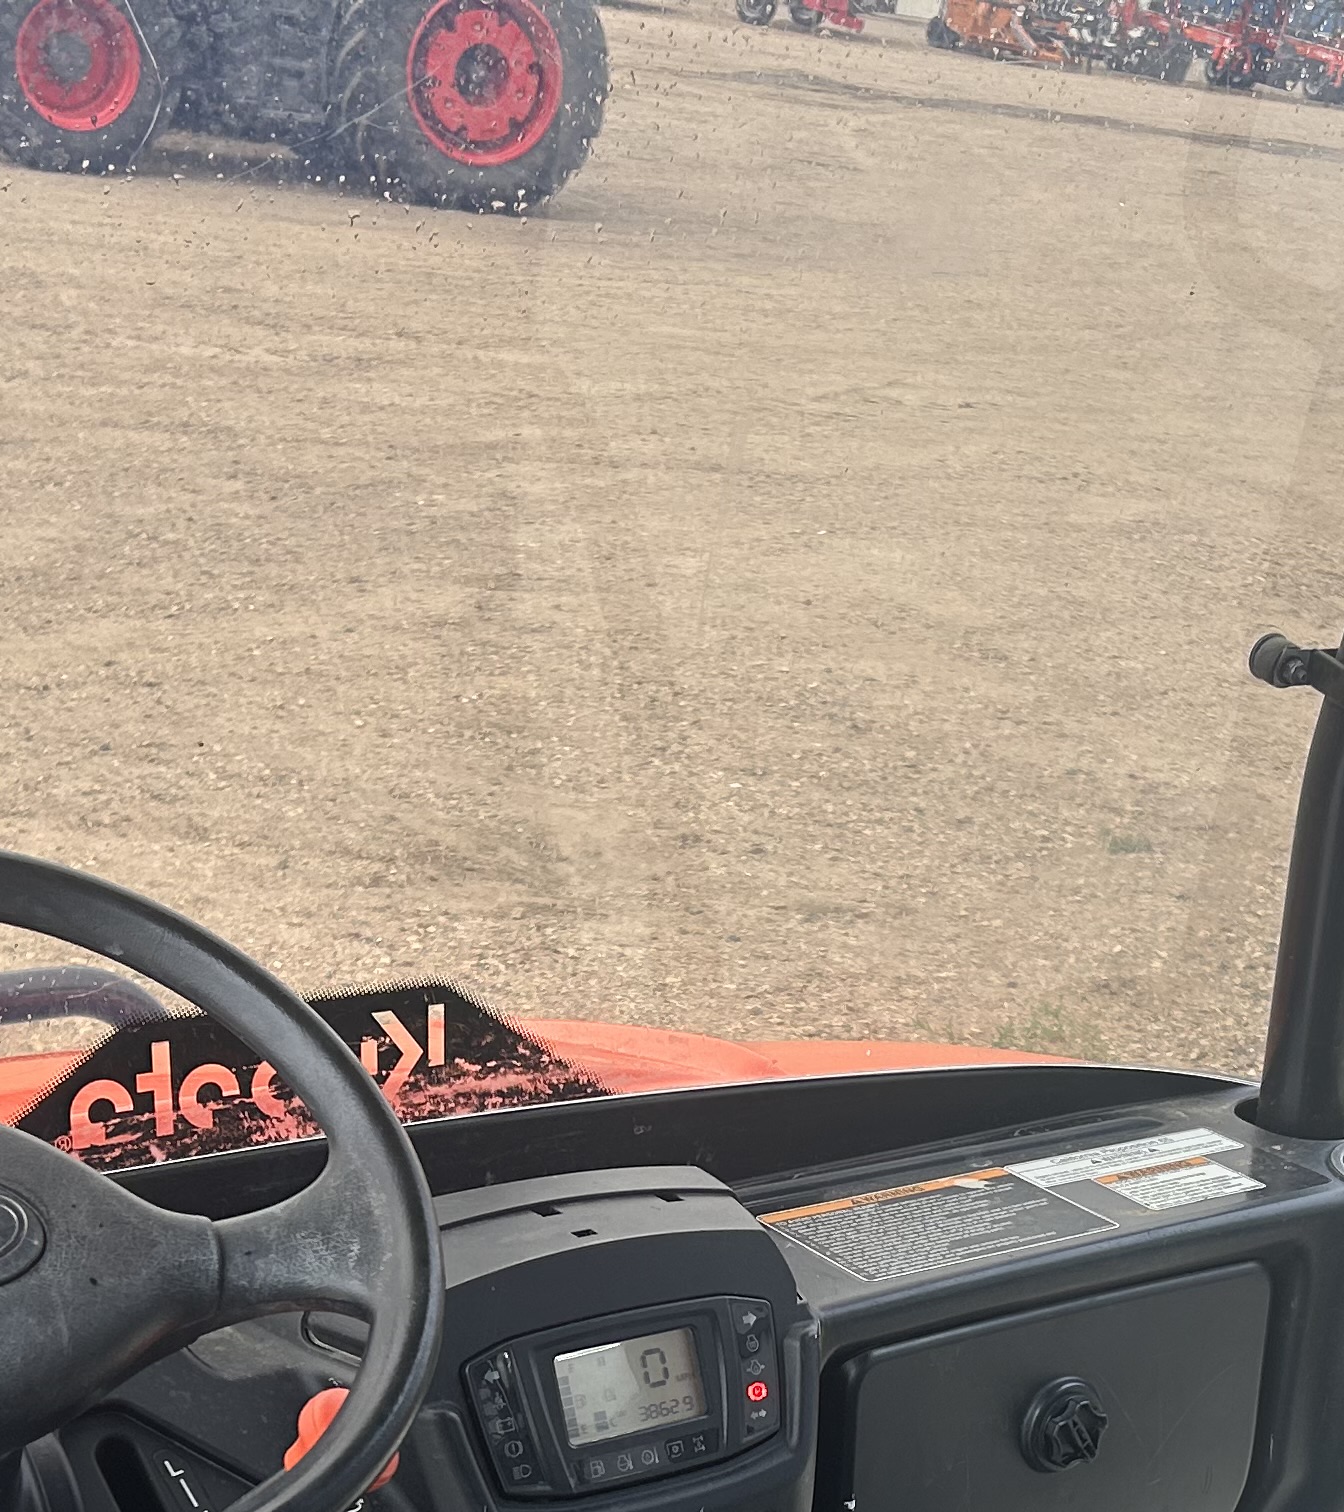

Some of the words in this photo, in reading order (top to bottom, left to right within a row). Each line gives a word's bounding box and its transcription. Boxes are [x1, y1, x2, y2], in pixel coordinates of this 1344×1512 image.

[864, 1186, 925, 1203] WARNING
[641, 1347, 670, 1388] 0
[164, 1460, 185, 1477] L
